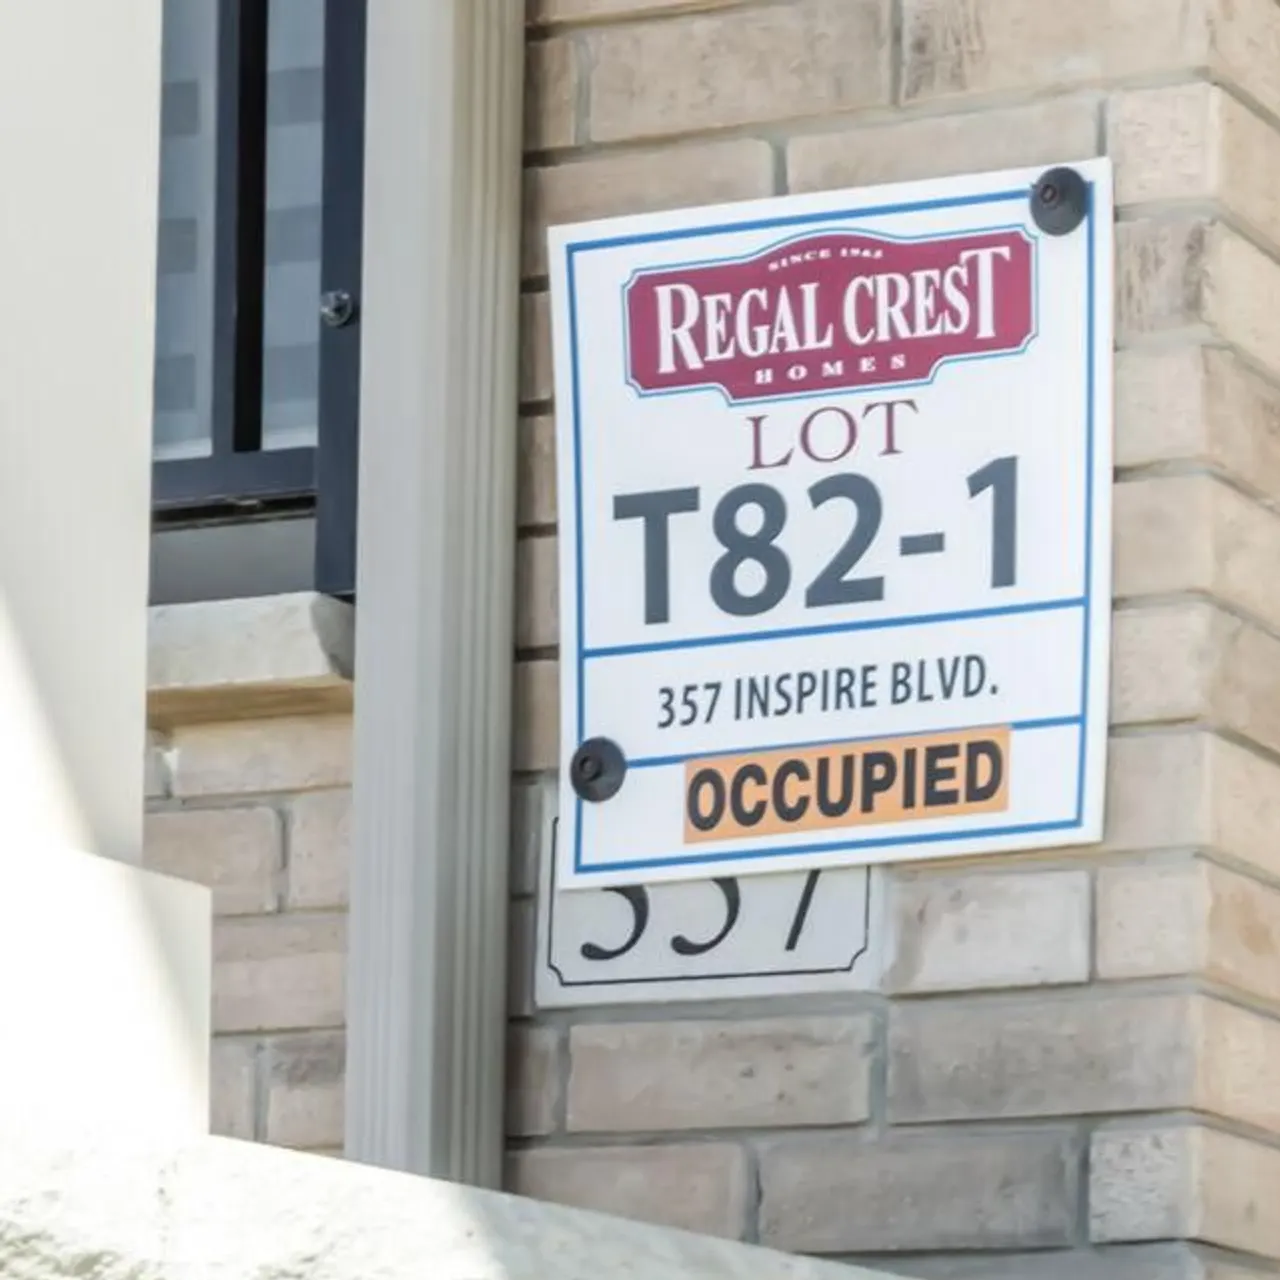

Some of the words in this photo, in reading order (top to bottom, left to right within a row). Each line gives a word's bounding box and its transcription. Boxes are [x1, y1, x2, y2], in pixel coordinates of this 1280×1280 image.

[655, 282, 833, 374] REGAL
[843, 246, 1012, 346] CREST
[755, 354, 907, 385] HOMES
[745, 399, 918, 470] LOT
[613, 455, 1019, 626] T82-1
[657, 681, 722, 729] 357
[734, 663, 878, 721] INSPIRE
[891, 653, 1000, 706] BLVD.
[686, 739, 1004, 832] OCCUPIED
